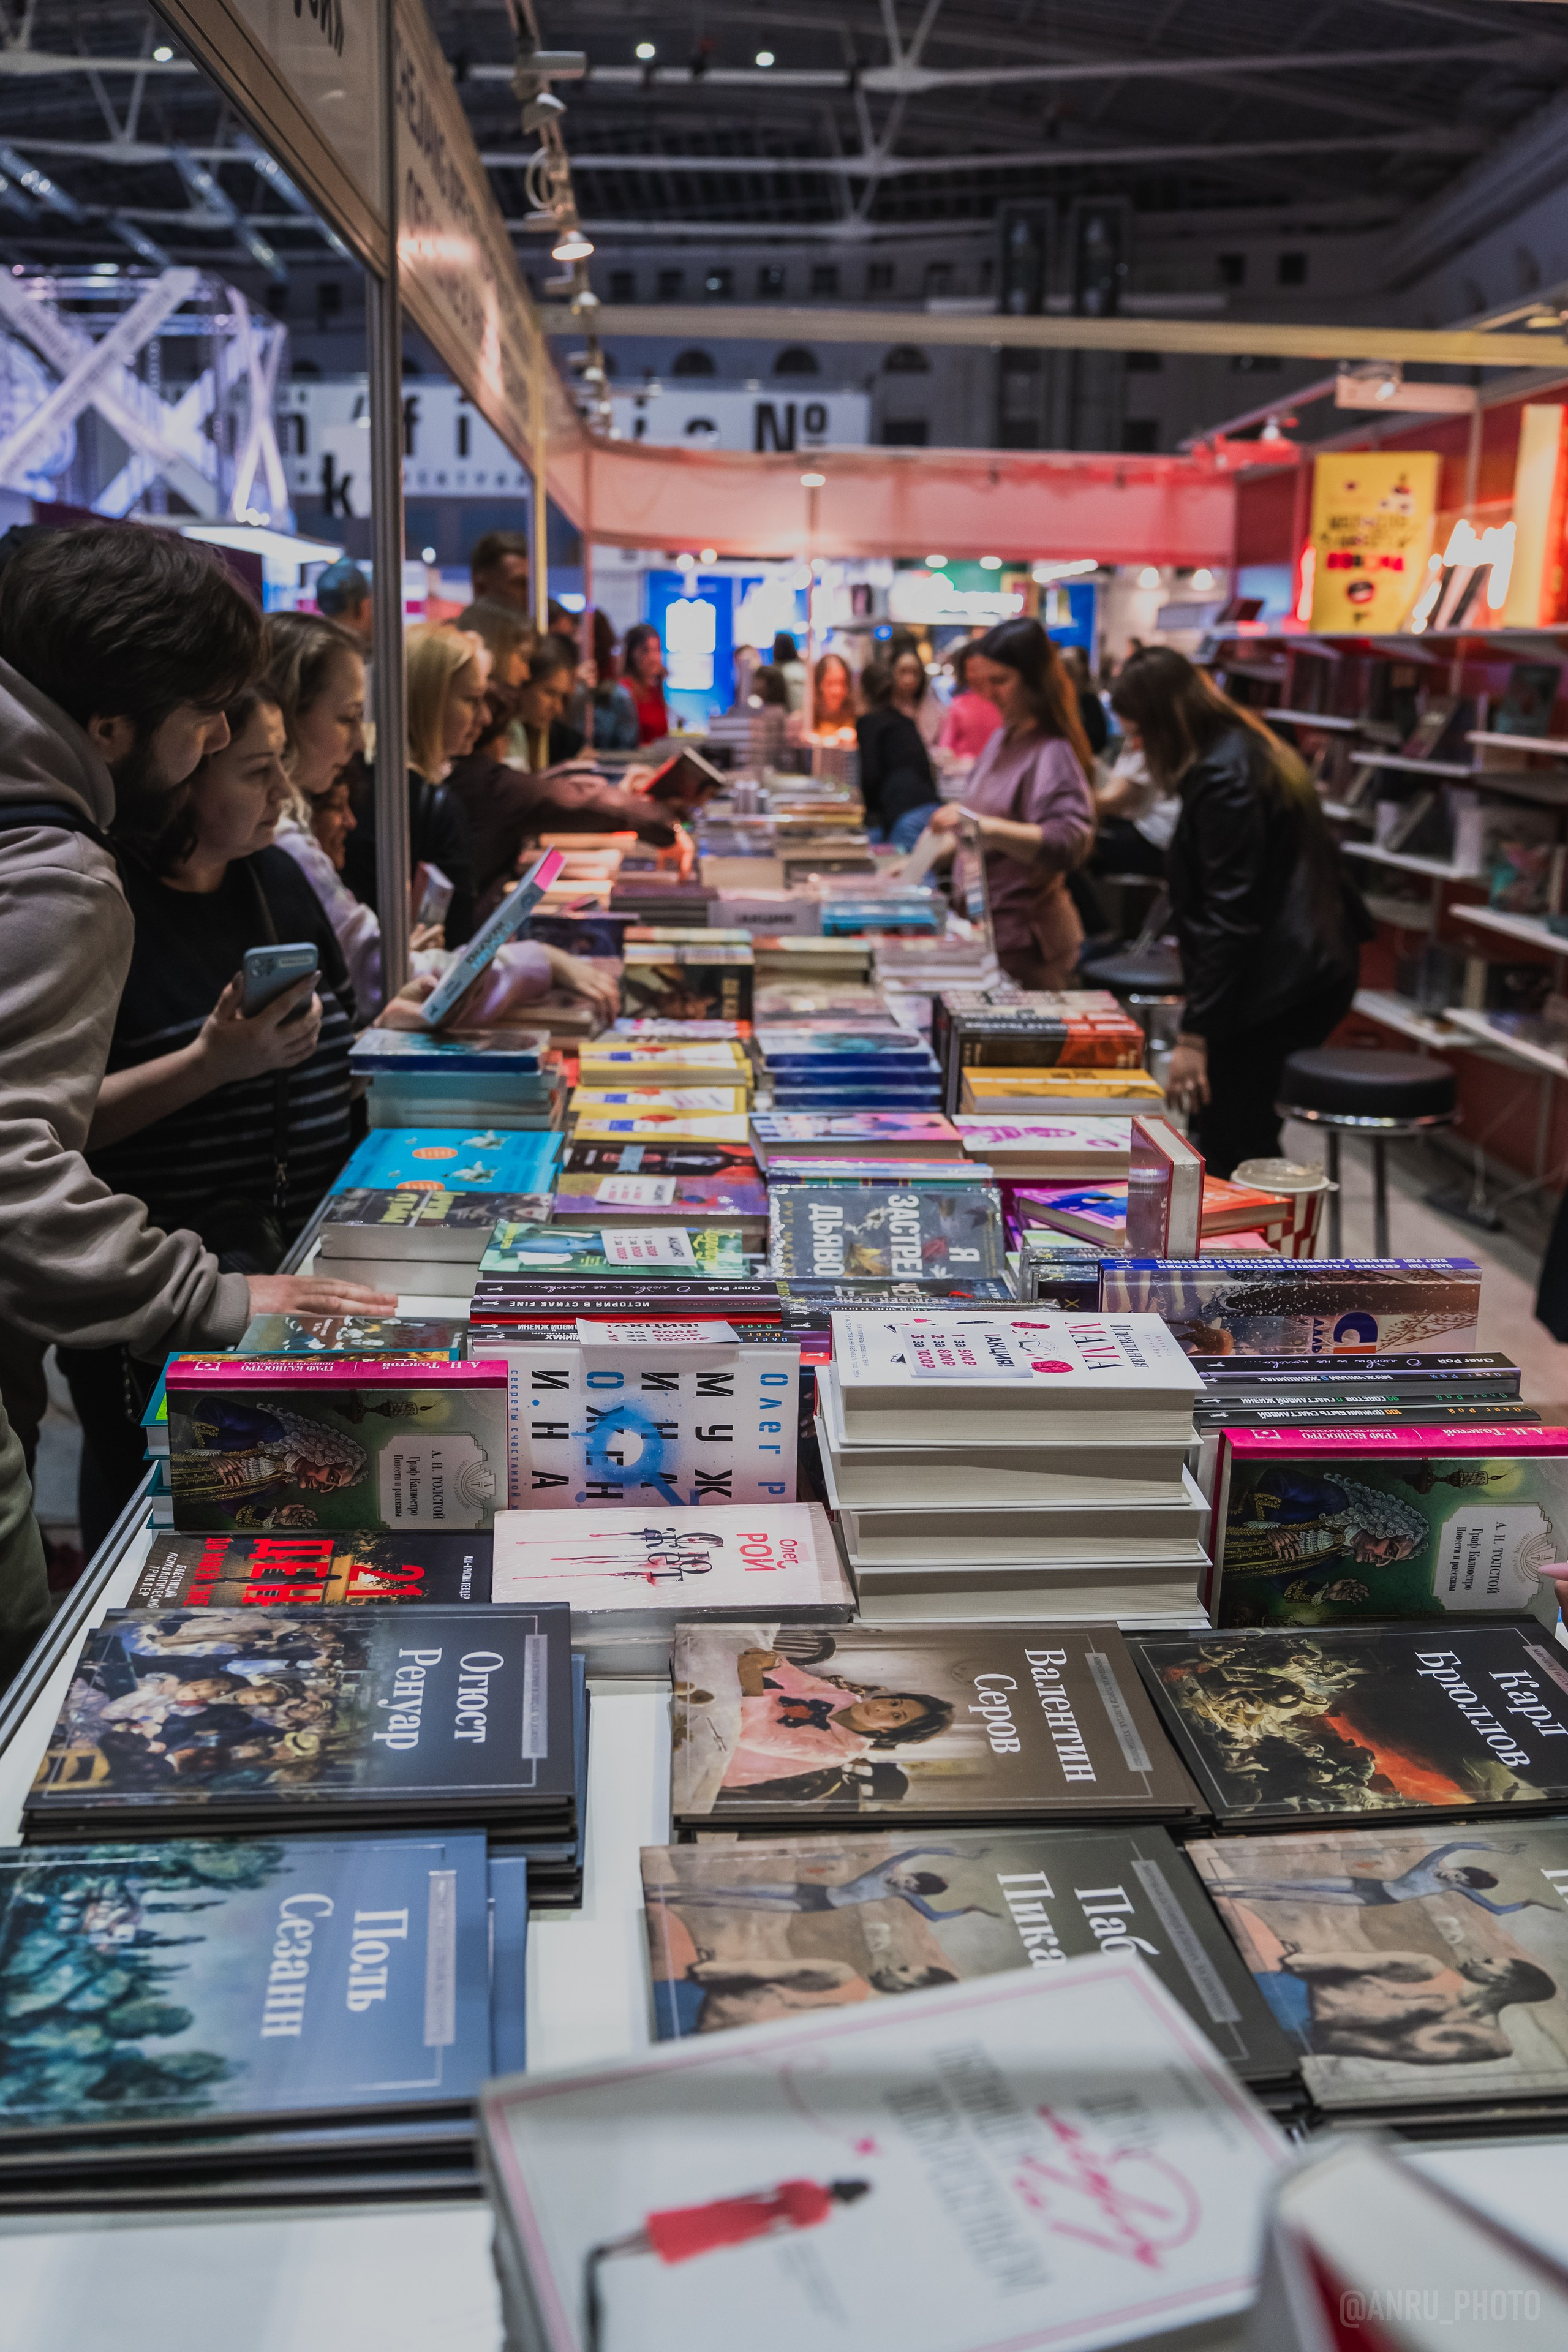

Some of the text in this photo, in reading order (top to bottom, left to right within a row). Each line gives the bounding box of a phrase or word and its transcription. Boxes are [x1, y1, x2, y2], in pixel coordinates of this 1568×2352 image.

[808, 1203, 845, 1276] ДЬЯВО
[948, 1246, 981, 1262] Я
[1065, 1321, 1125, 1371] МАМА
[1110, 1324, 1150, 1368] Идеальная
[1355, 1359, 1398, 1369] любви
[509, 1370, 521, 1497] секреты счастливой
[531, 1370, 570, 1490] ИНА
[640, 1372, 679, 1488] ИНА
[695, 1372, 735, 1498] МУЖ
[758, 1373, 788, 1455] Олег
[1257, 1411, 1319, 1419] СЧАСТЛИВОЙ
[1442, 1428, 1506, 1437] Толстой
[393, 1454, 404, 1480] Повести
[406, 1456, 421, 1517] Граф Калиостро
[432, 1450, 446, 1520] А. Н. ТОЛСТОЙ
[586, 1405, 624, 1499] ЖЕН
[392, 1488, 402, 1517] рассказы
[183, 1537, 232, 1607] ДО МОЕЙ СМЕ
[242, 1538, 334, 1607] ДЕН
[736, 1532, 787, 1572] РОЙ
[778, 1538, 799, 1564] Олег
[1453, 1526, 1467, 1554] Повести
[1461, 1528, 1483, 1591] Граф Калиостро
[1486, 1521, 1507, 1594] А. Н. ТОЛСТОЙ
[138, 1565, 160, 1597] ТРИЛЛЕР
[164, 1564, 188, 1599] БЛЕСТЯЩИЙ
[345, 1564, 426, 1596] 21
[1448, 1561, 1460, 1591] рассказы
[1531, 1648, 1558, 1672] МИРОВАЯ
[372, 1646, 443, 1752] Ренуар
[453, 1649, 505, 1744] Огюст
[968, 1673, 1022, 1754] Серов
[1024, 1648, 1097, 1783] Валентин
[1414, 1649, 1531, 1767] Брюллов
[1488, 1669, 1568, 1737] Карл
[996, 1870, 1067, 1969] Пика
[1074, 1884, 1161, 1956] Паб
[259, 1892, 335, 2039] Сезанн
[345, 1907, 409, 2013] Поль
